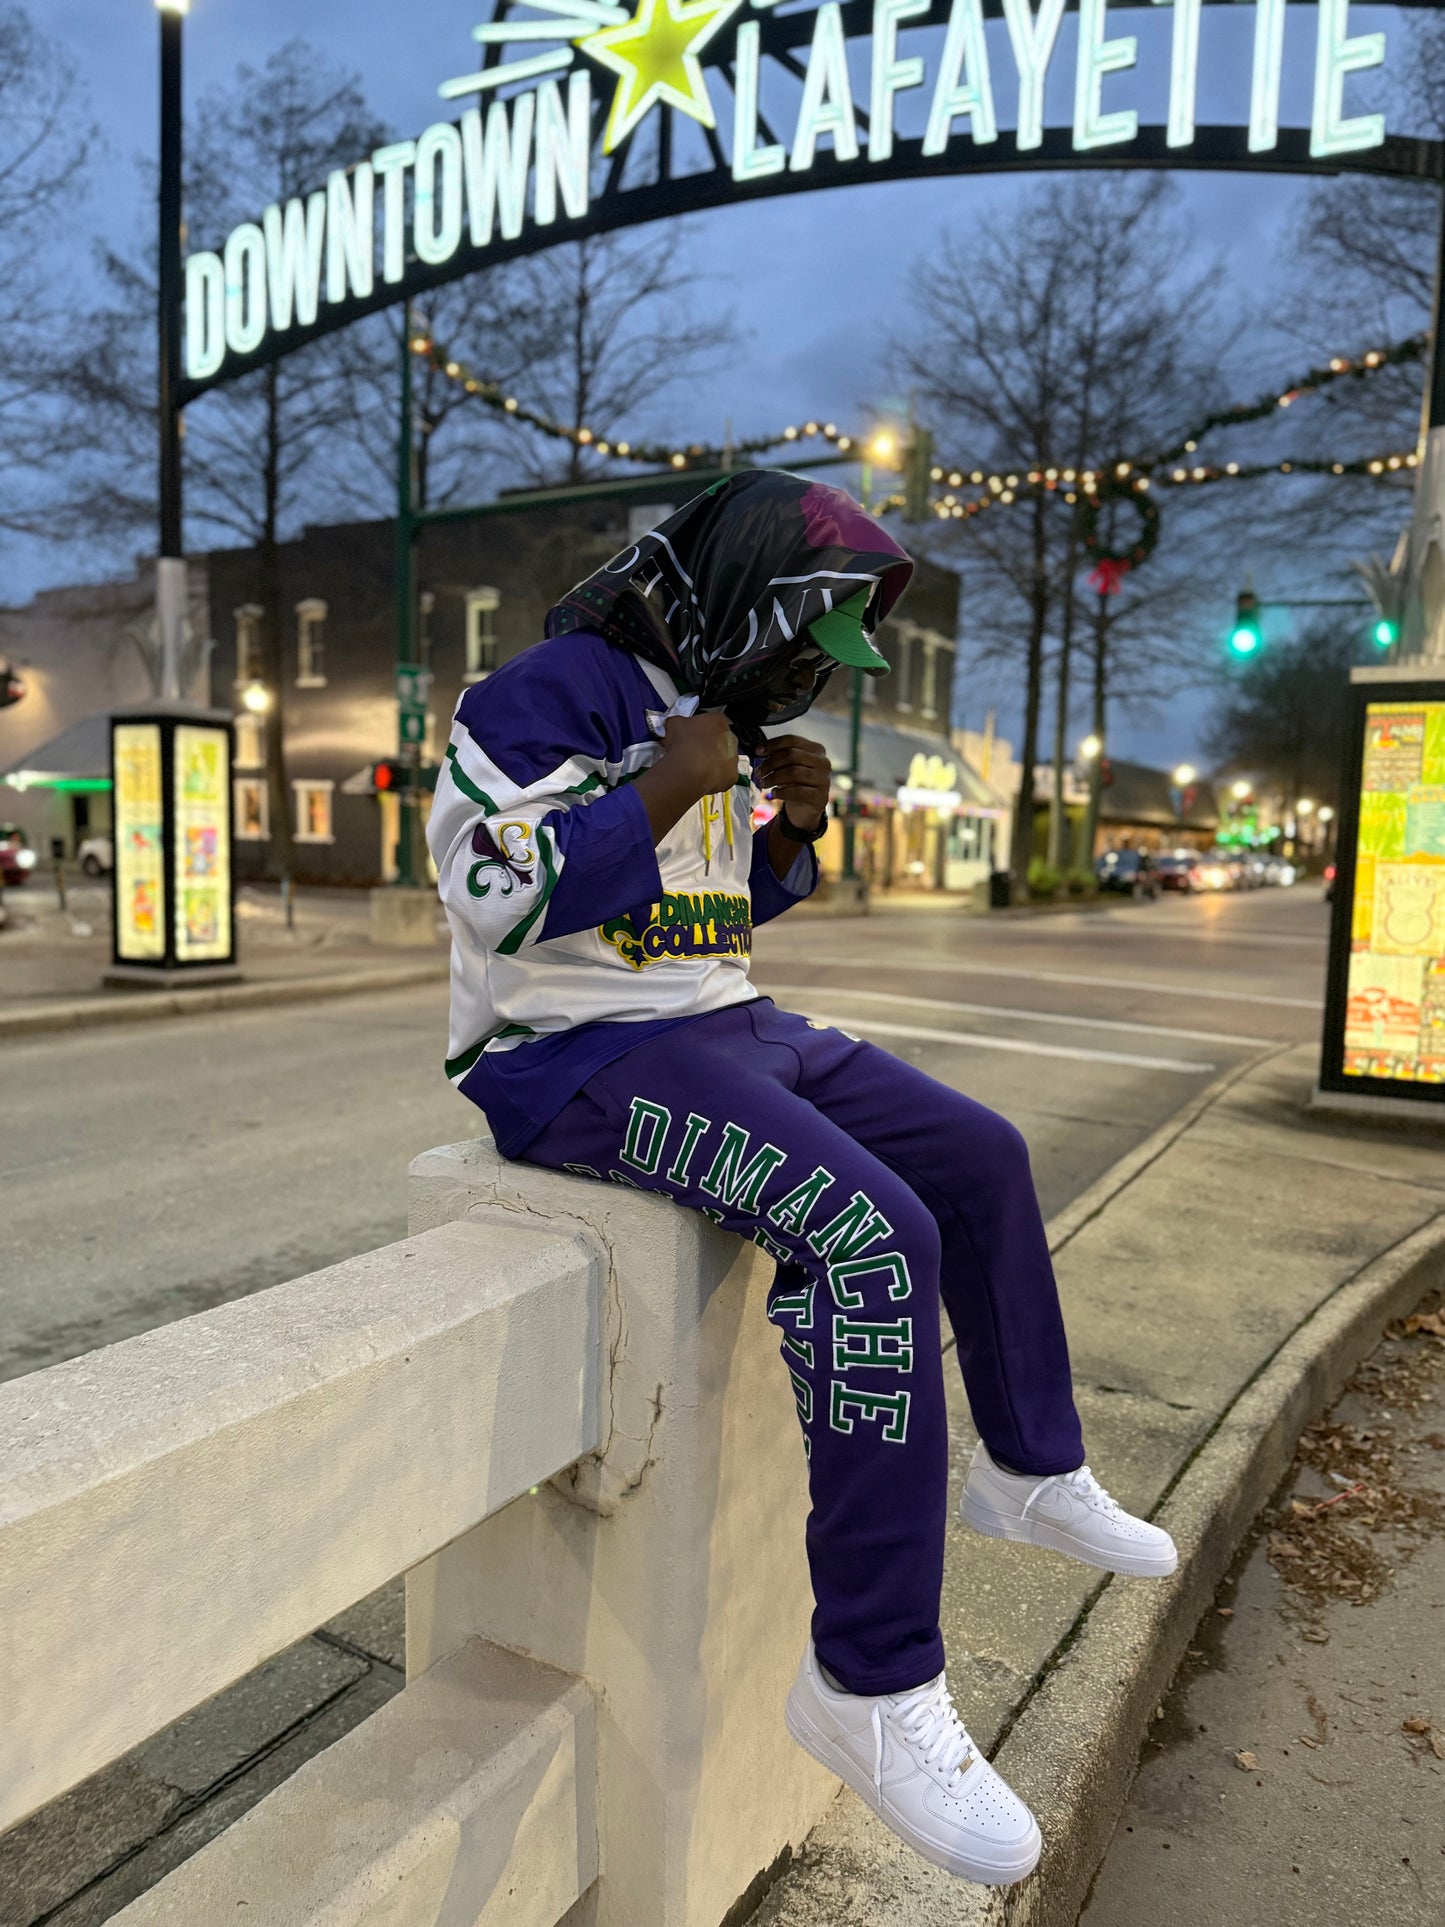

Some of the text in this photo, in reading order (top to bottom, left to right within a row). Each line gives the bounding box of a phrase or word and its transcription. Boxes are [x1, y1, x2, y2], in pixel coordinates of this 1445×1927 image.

[185, 0, 1386, 380] DOWNTOWN LAFAYETTE
[619, 1096, 914, 1444] DIMANCHE
